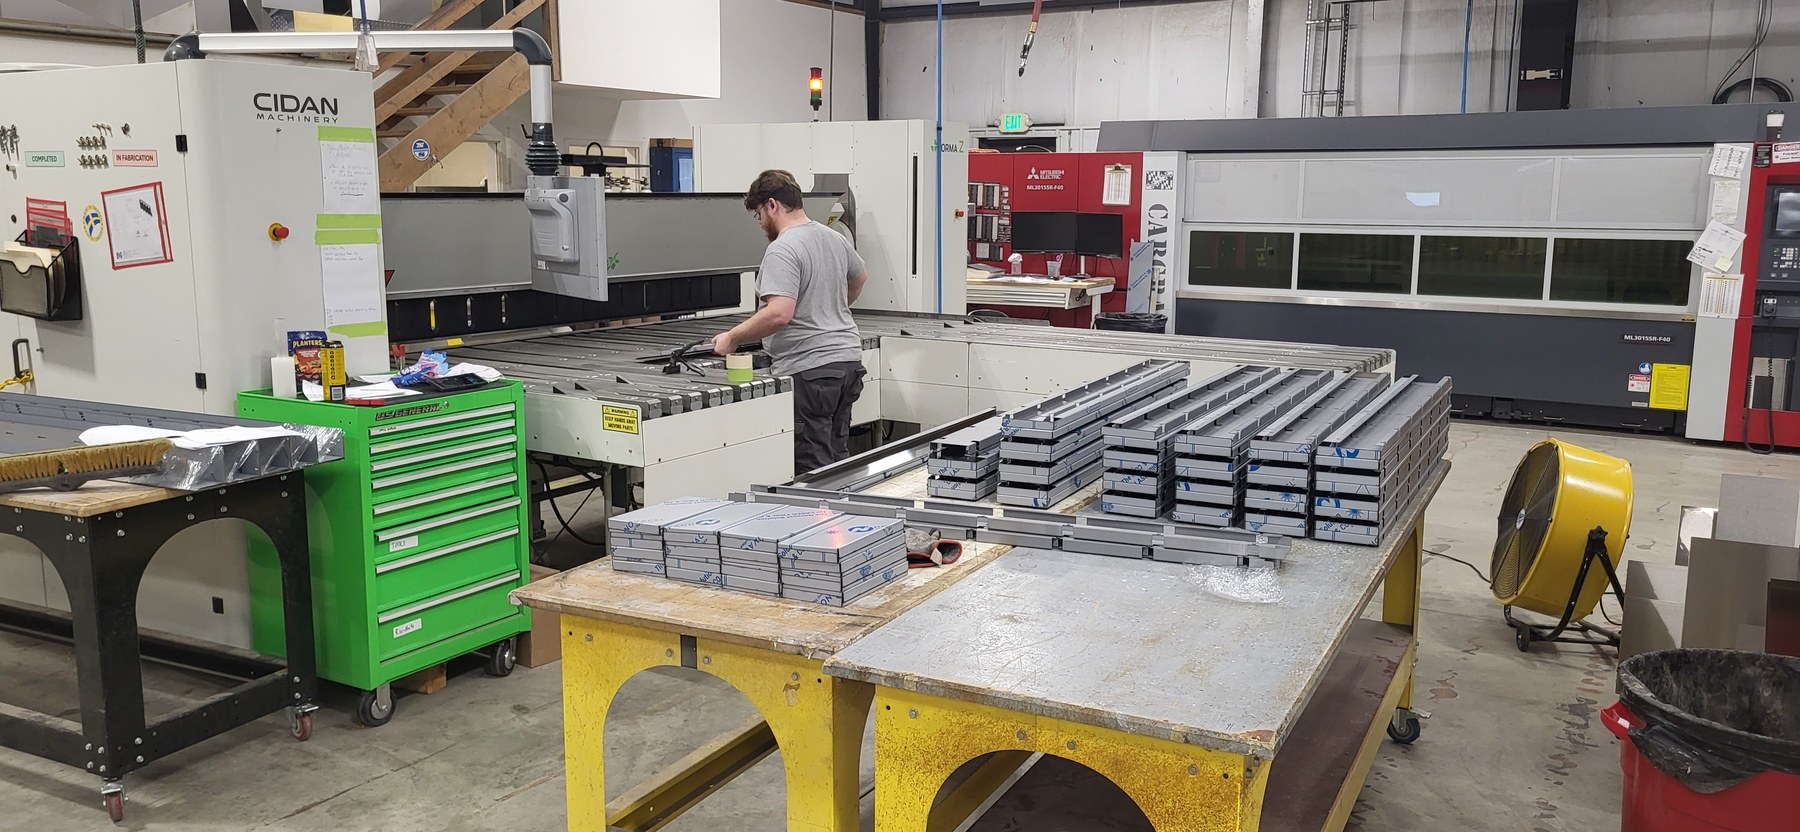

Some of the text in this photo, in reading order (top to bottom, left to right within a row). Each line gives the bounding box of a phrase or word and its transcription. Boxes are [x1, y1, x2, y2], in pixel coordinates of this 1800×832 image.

[253, 92, 338, 116] CIDAN
[256, 113, 338, 124] MACHINERY
[1004, 115, 1022, 130] EXIT
[940, 140, 964, 153] ORMA Z
[31, 155, 58, 163] COMPLETED
[122, 154, 154, 162] FABRICATION
[1623, 334, 1671, 343] ML3015SR-F40
